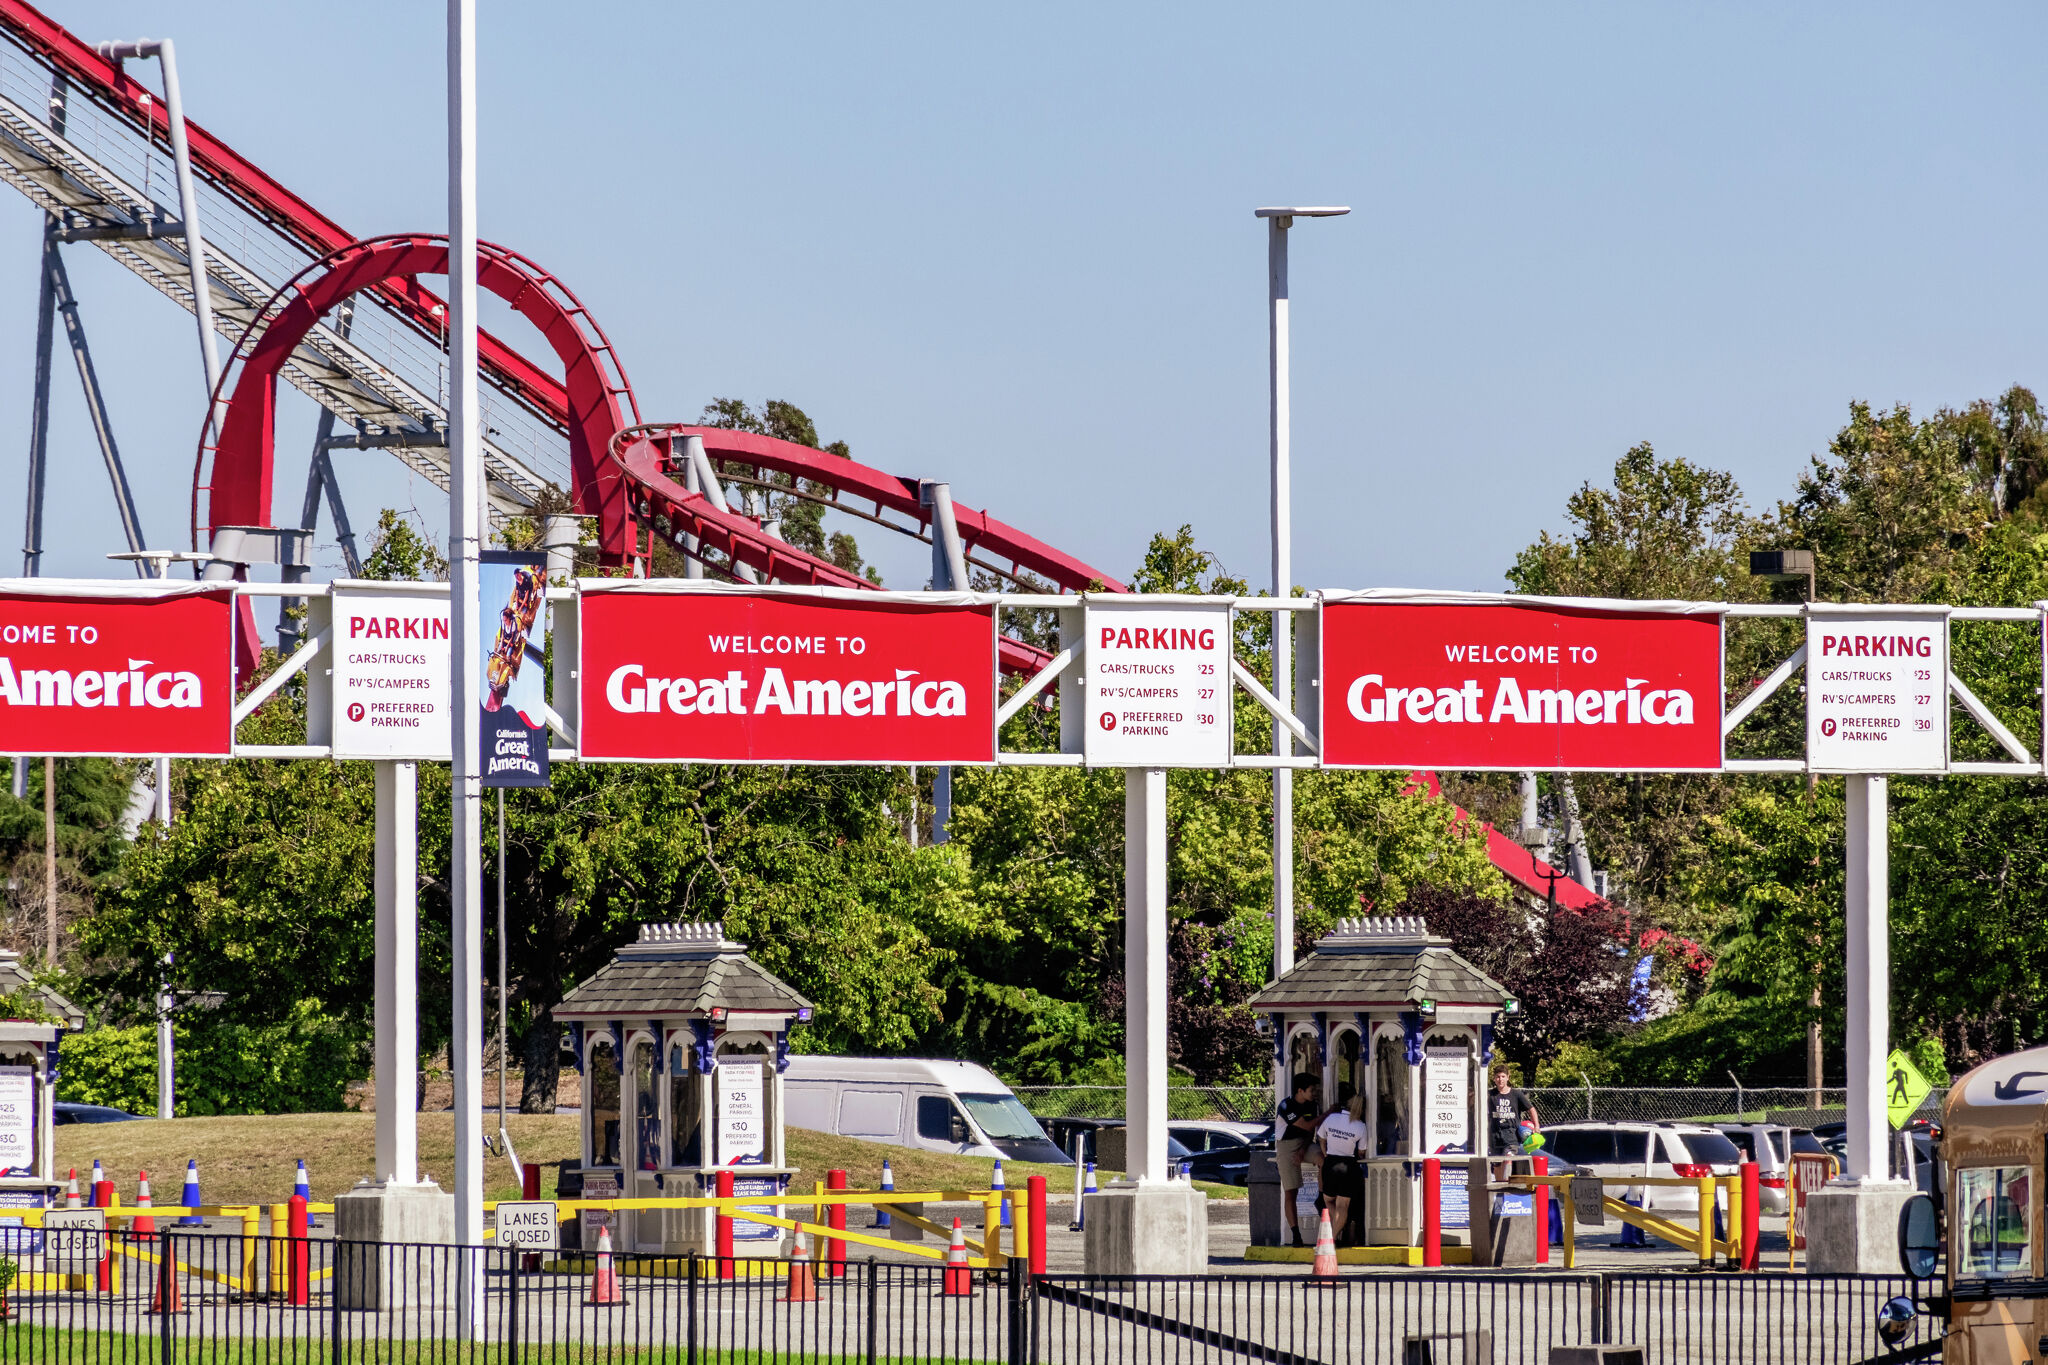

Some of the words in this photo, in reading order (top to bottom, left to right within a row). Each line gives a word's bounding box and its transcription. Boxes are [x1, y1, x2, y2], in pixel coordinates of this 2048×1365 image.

[350, 616, 449, 640] PARKIN
[0, 625, 56, 644] OME
[66, 626, 98, 644] TO
[1100, 627, 1215, 650] PARKING
[709, 635, 825, 654] WELCOME
[836, 637, 866, 655] TO
[1822, 635, 1931, 658] PARKING
[348, 653, 426, 664] CARS/TRUCKS
[1445, 644, 1559, 664] WELCOME
[1569, 646, 1598, 664] TO
[1100, 663, 1175, 675] CARS/TRUCKS
[1197, 664, 1215, 675] $25
[1821, 671, 1892, 681] CARS/TRUCKS
[1913, 669, 1931, 680] $25
[348, 677, 430, 689] RV'S/CAMPERS
[606, 664, 748, 715] Great
[753, 667, 967, 717] America
[1100, 687, 1179, 698] RV'S/CAMPERS
[1197, 688, 1214, 699] $27
[1346, 673, 1484, 724] Great
[1488, 676, 1694, 725] America
[1821, 694, 1896, 705] RV'S/CAMPERS
[1914, 695, 1931, 705] $27
[371, 702, 434, 713] PREFERRED
[371, 717, 420, 727] PARKING
[1122, 711, 1183, 722] PREFERRED
[1196, 714, 1215, 725] $30
[1842, 717, 1901, 728] PREFERRED
[1914, 719, 1931, 730] $30
[1122, 726, 1169, 736] PARKING
[1842, 731, 1888, 741] PARKING
[495, 738, 530, 757] Great
[487, 756, 540, 775] America
[1438, 1083, 1453, 1093] $25
[731, 1092, 747, 1101] $25
[1499, 1098, 1511, 1107] NO
[1437, 1112, 1453, 1121] $30
[731, 1121, 748, 1131] $30
[1328, 1127, 1355, 1138] SUPERVISOR
[1503, 1200, 1523, 1208] Great
[1502, 1206, 1532, 1215] America
[504, 1212, 548, 1226] LANES
[52, 1220, 96, 1231] LANES
[502, 1230, 550, 1243] CLOSED
[51, 1236, 98, 1250] CLOSED
